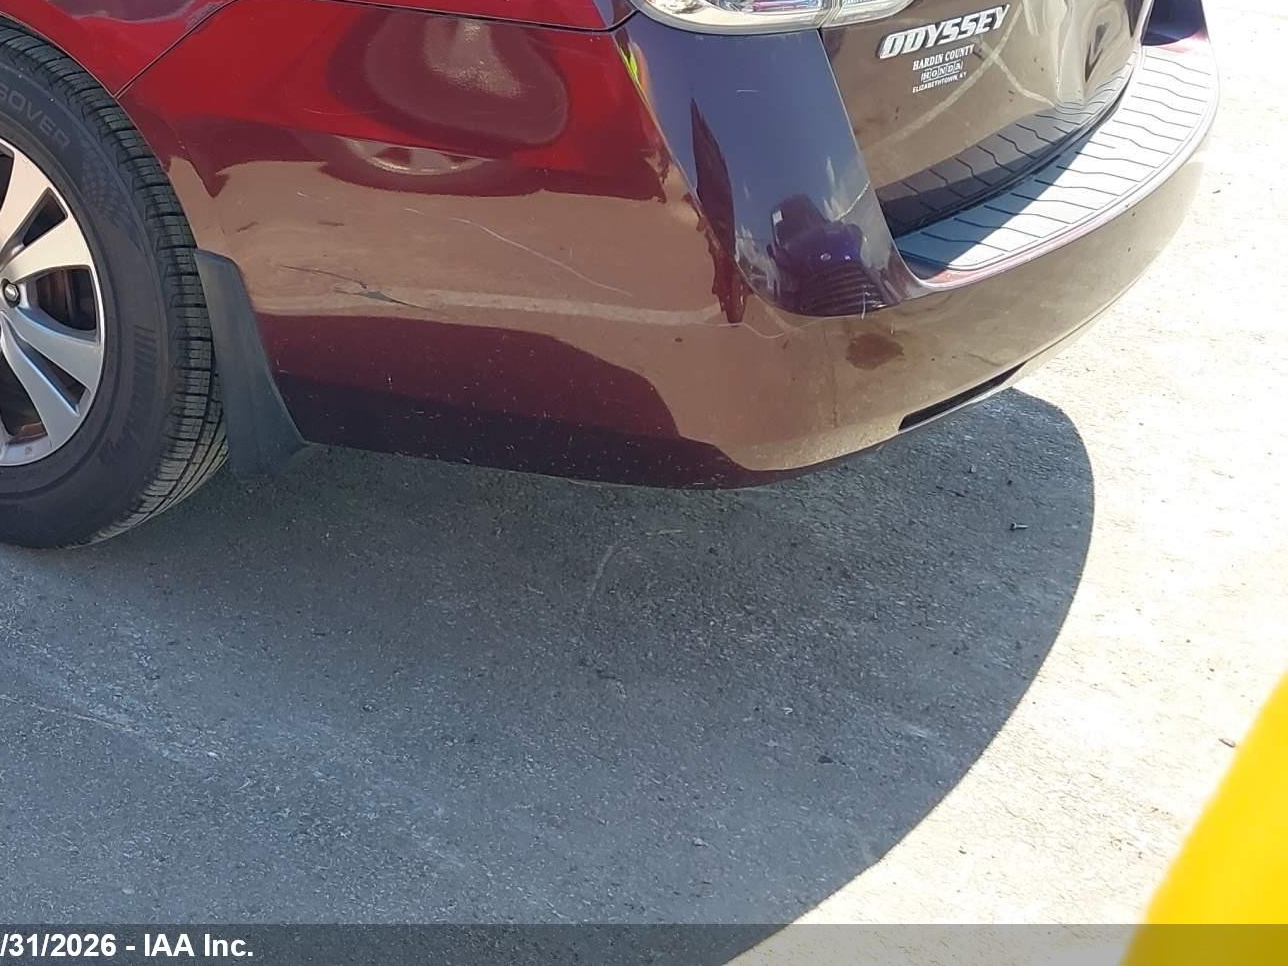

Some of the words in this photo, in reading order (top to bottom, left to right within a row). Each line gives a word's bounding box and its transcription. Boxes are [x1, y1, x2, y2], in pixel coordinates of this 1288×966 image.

[878, 4, 1010, 59] ODYSSEY
[912, 53, 944, 71] HARDIN
[944, 44, 974, 62] COUNTY
[921, 60, 963, 83] HONDA
